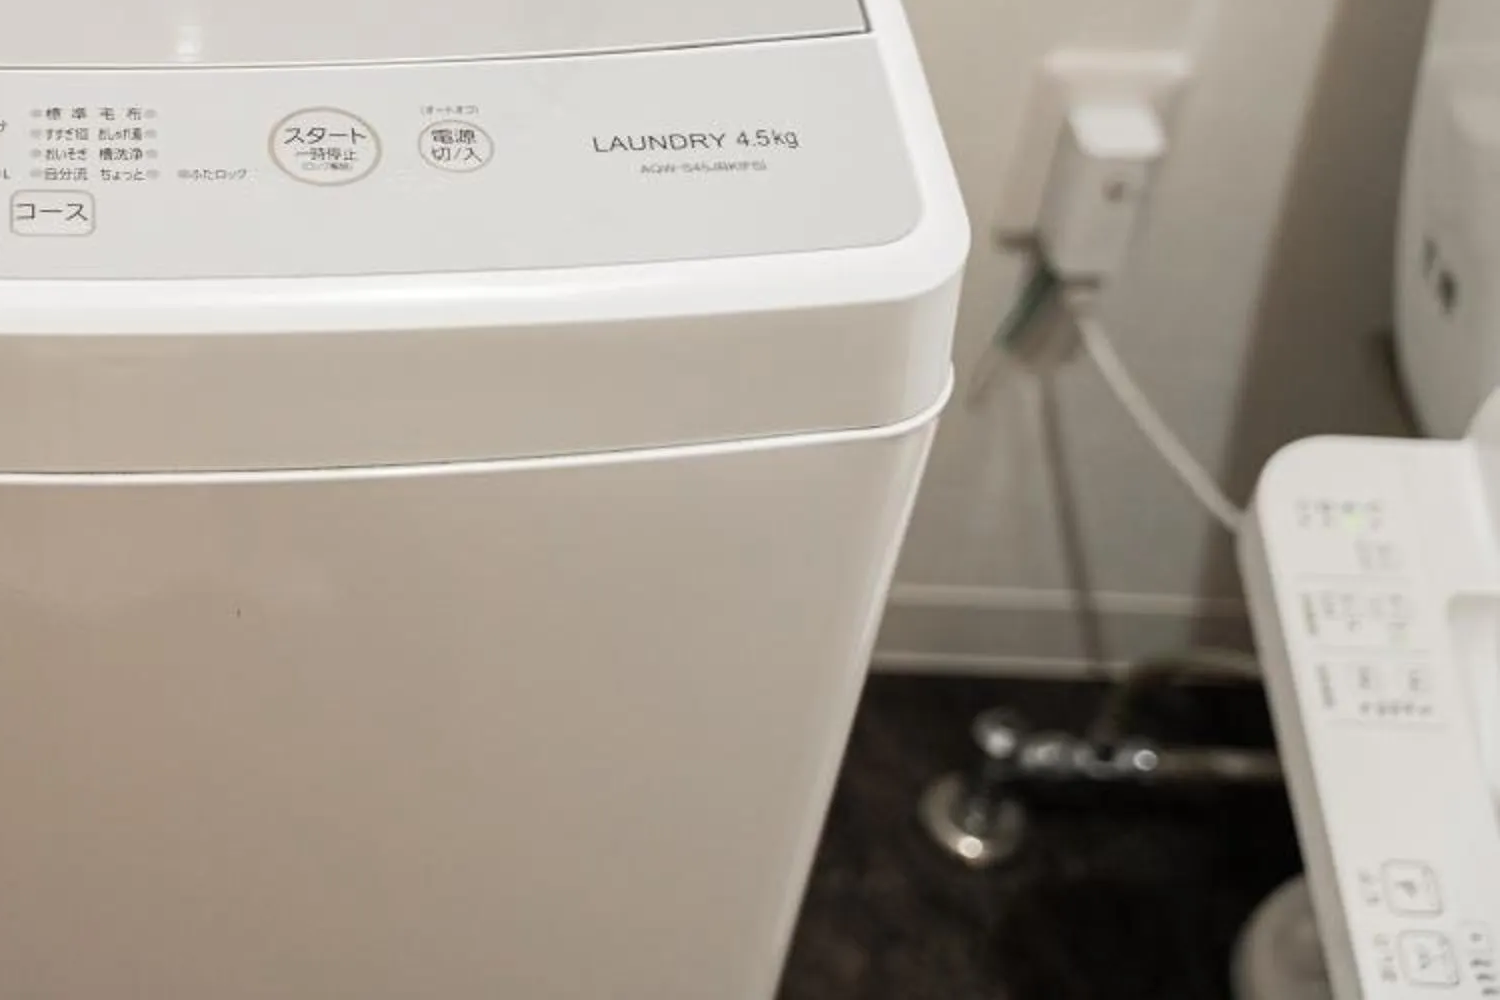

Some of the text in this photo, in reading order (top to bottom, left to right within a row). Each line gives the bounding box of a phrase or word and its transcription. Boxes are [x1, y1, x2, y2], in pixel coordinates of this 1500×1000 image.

[284, 127, 368, 145] スタート
[431, 128, 477, 145] 電源
[592, 128, 800, 153] LAUNDRY 4.5kg
[16, 203, 89, 222] コース
